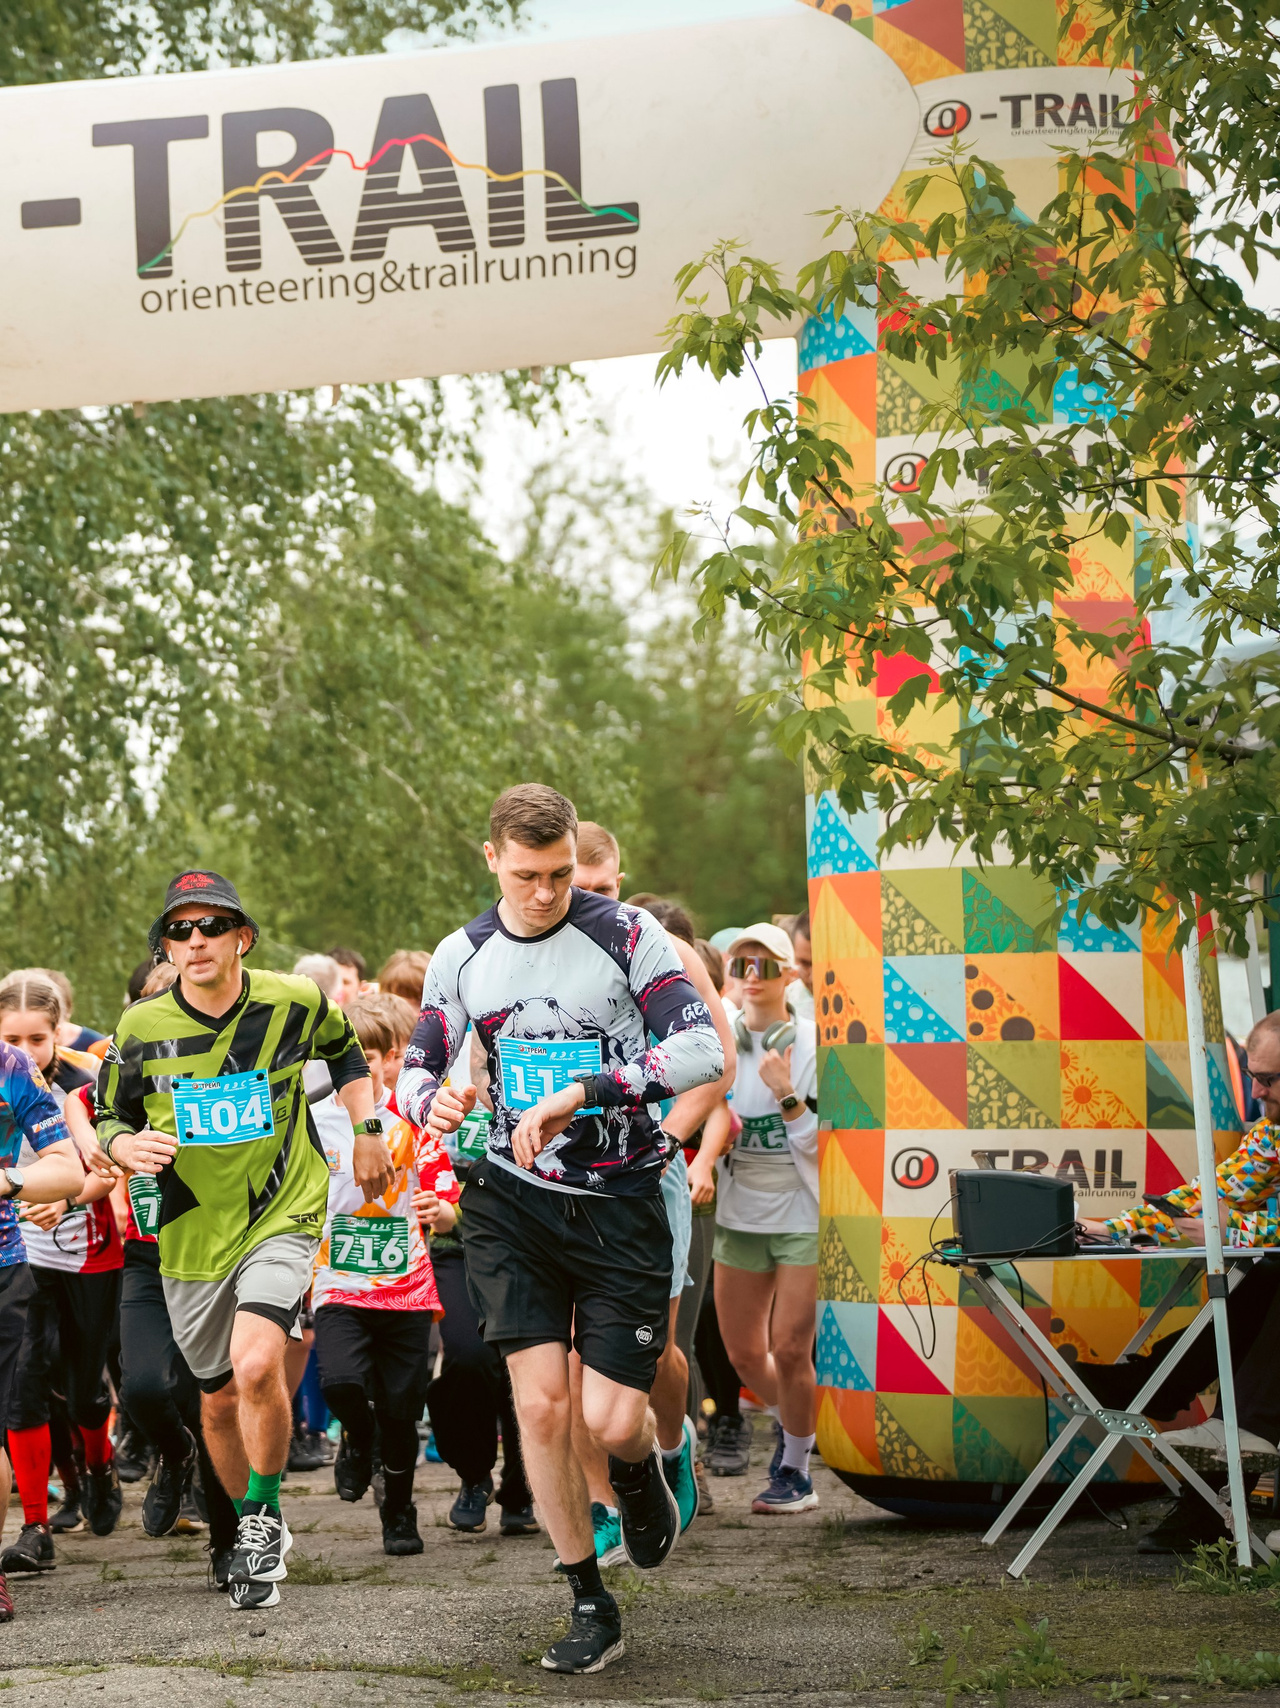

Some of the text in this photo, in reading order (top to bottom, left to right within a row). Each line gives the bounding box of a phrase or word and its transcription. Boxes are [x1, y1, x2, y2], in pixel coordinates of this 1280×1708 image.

[141, 244, 639, 314] orienteering&trailrunning
[184, 1094, 266, 1135] 104
[1073, 1187, 1137, 1199] railrunning
[334, 1235, 404, 1268] 716
